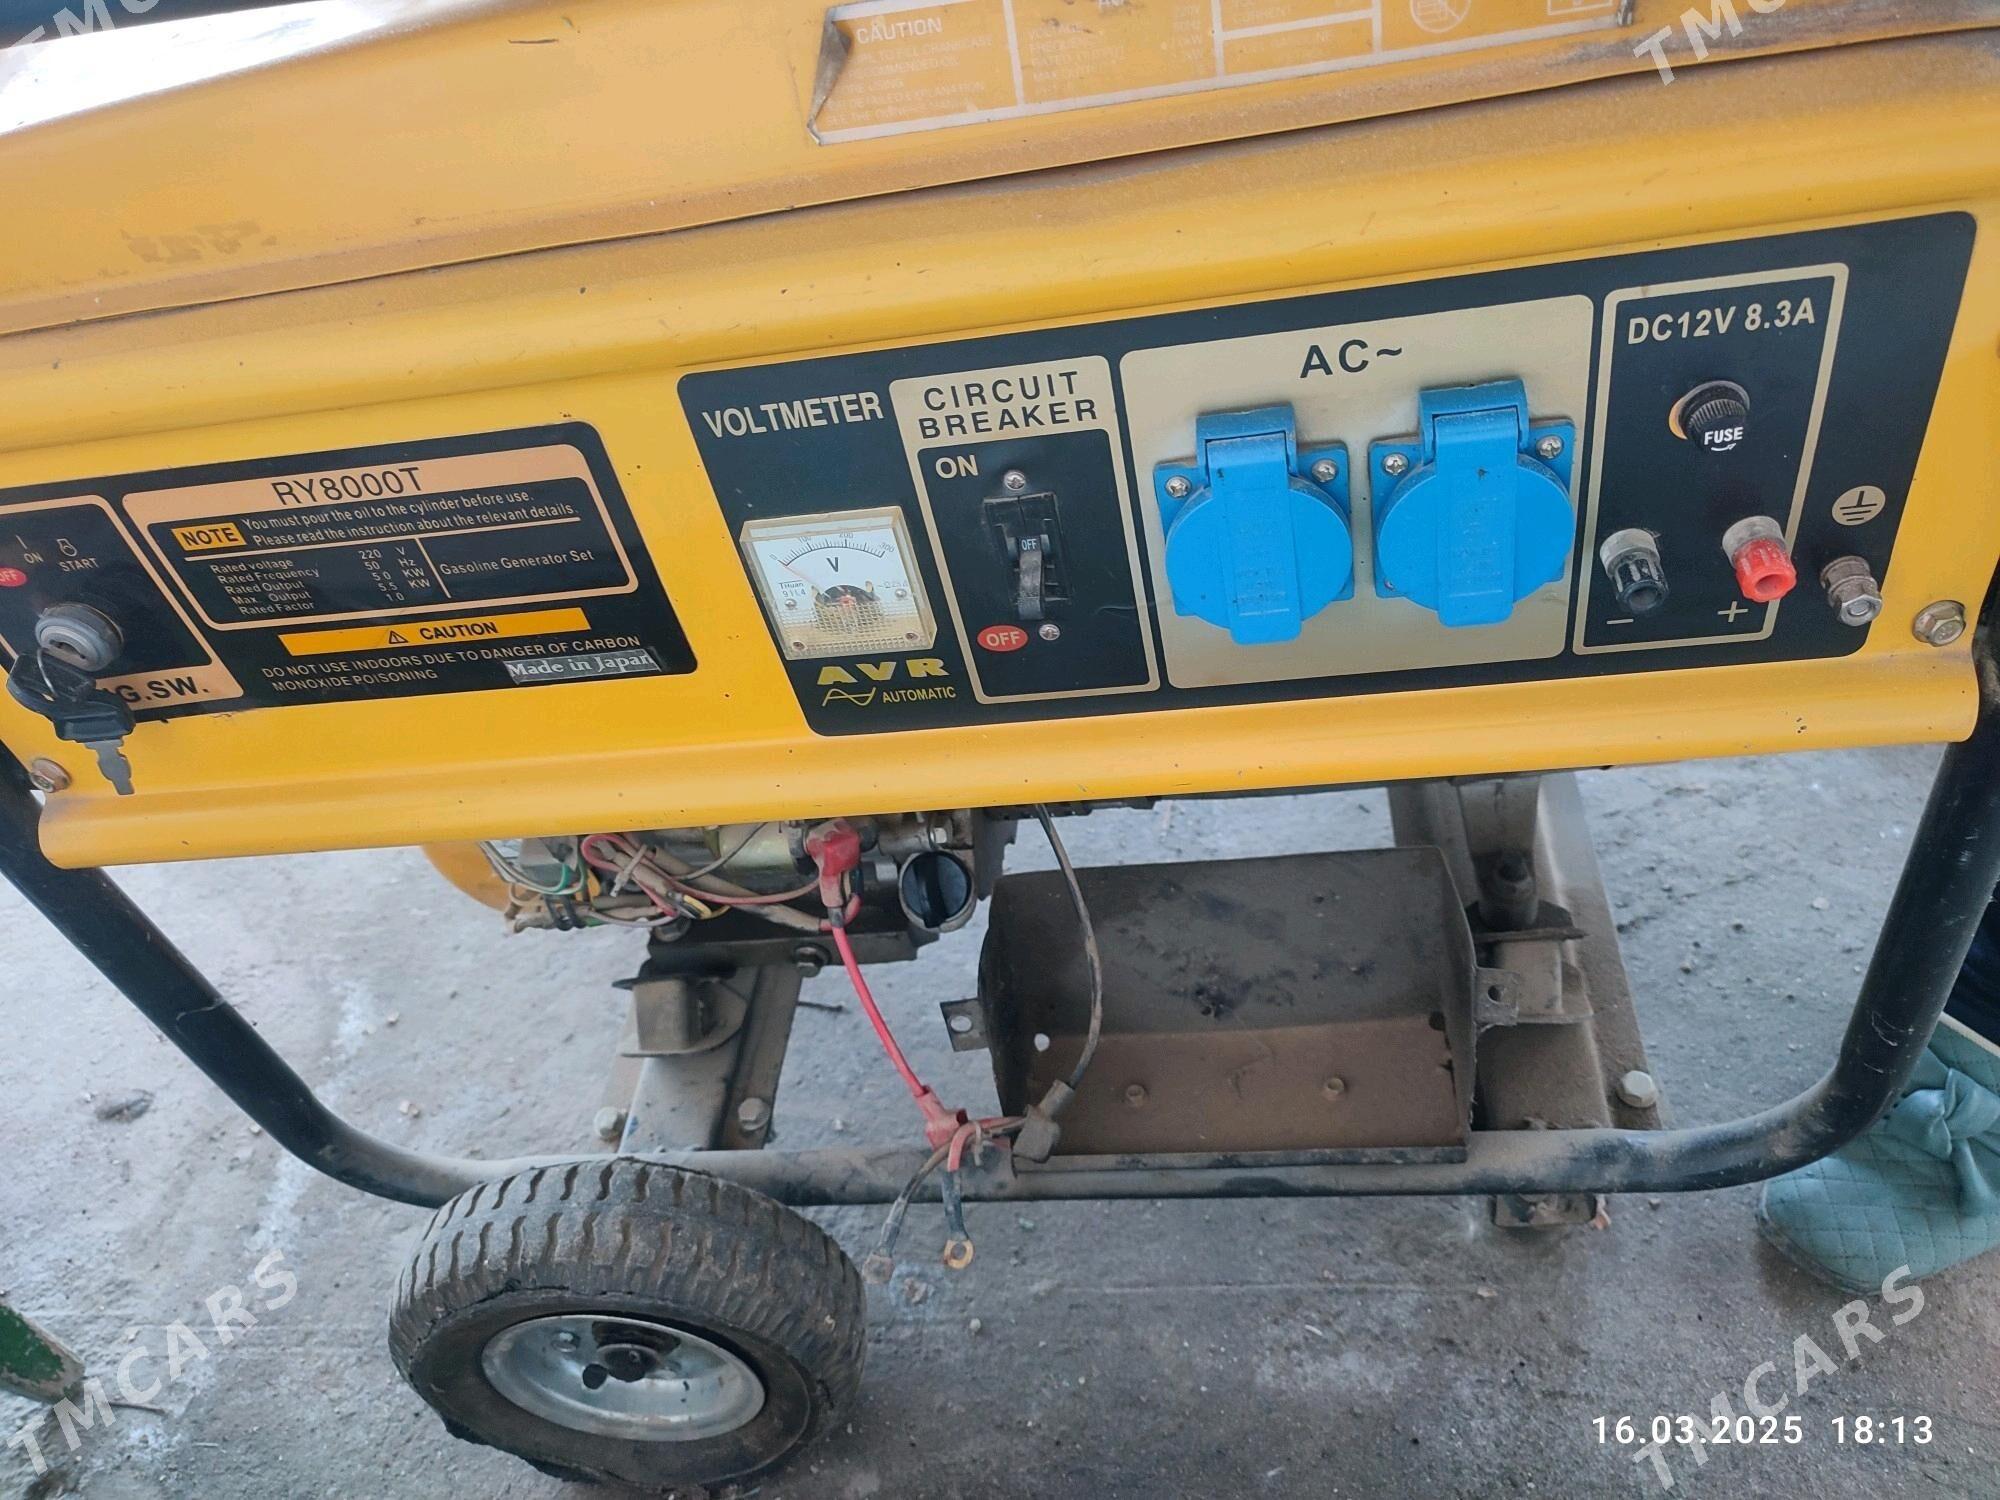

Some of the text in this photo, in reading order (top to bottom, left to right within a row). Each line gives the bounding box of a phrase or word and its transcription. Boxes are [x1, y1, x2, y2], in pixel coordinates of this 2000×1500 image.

[855, 17, 943, 44] CAUTION
[1628, 297, 1816, 345] DC12V 8.3A
[924, 371, 1078, 411] CIRCUIT
[702, 391, 885, 438] VOLTMETER
[919, 399, 1097, 439] BREAKER
[1704, 426, 1744, 445] FUSE
[935, 454, 979, 478] ON
[271, 466, 421, 506] RY8000T
[242, 518, 267, 531] You
[269, 515, 301, 528] must
[303, 511, 330, 529] pour
[332, 509, 352, 522] the
[354, 506, 369, 519] oil
[371, 505, 385, 517] to
[386, 502, 407, 516] the
[409, 498, 459, 516] cylinder
[460, 493, 503, 508] before
[181, 527, 239, 546] NOTE
[252, 531, 295, 547] Please
[296, 528, 324, 544] read
[325, 525, 346, 539] the
[346, 520, 415, 539] instruction
[417, 516, 455, 530] about
[454, 514, 475, 527] the
[475, 508, 530, 525] relevant
[1021, 538, 1037, 551] OFF
[24, 552, 44, 564] ON
[59, 557, 100, 572] START
[209, 546, 405, 574] Rated voltage 220 V
[439, 550, 594, 575] Gasoline Generator Set
[826, 557, 839, 573] V
[217, 558, 416, 584] Rated Frequency 50 Hz
[224, 584, 262, 595] Rated
[262, 580, 305, 592] Output
[402, 567, 425, 578] KW
[268, 591, 312, 602] Output
[408, 579, 431, 589] KW
[238, 604, 277, 616] Rated
[276, 602, 315, 612] Factor
[419, 622, 499, 640] CAUTION
[986, 631, 1021, 647] OFF
[262, 635, 641, 678] DO NOT USE INDOORS DUE TO DANGER OF CARBON
[507, 653, 654, 678] Made in Japan
[271, 669, 438, 692] MONOXIDE POISONING
[817, 658, 950, 685] AVR
[882, 686, 956, 704] AUTOMATIC
